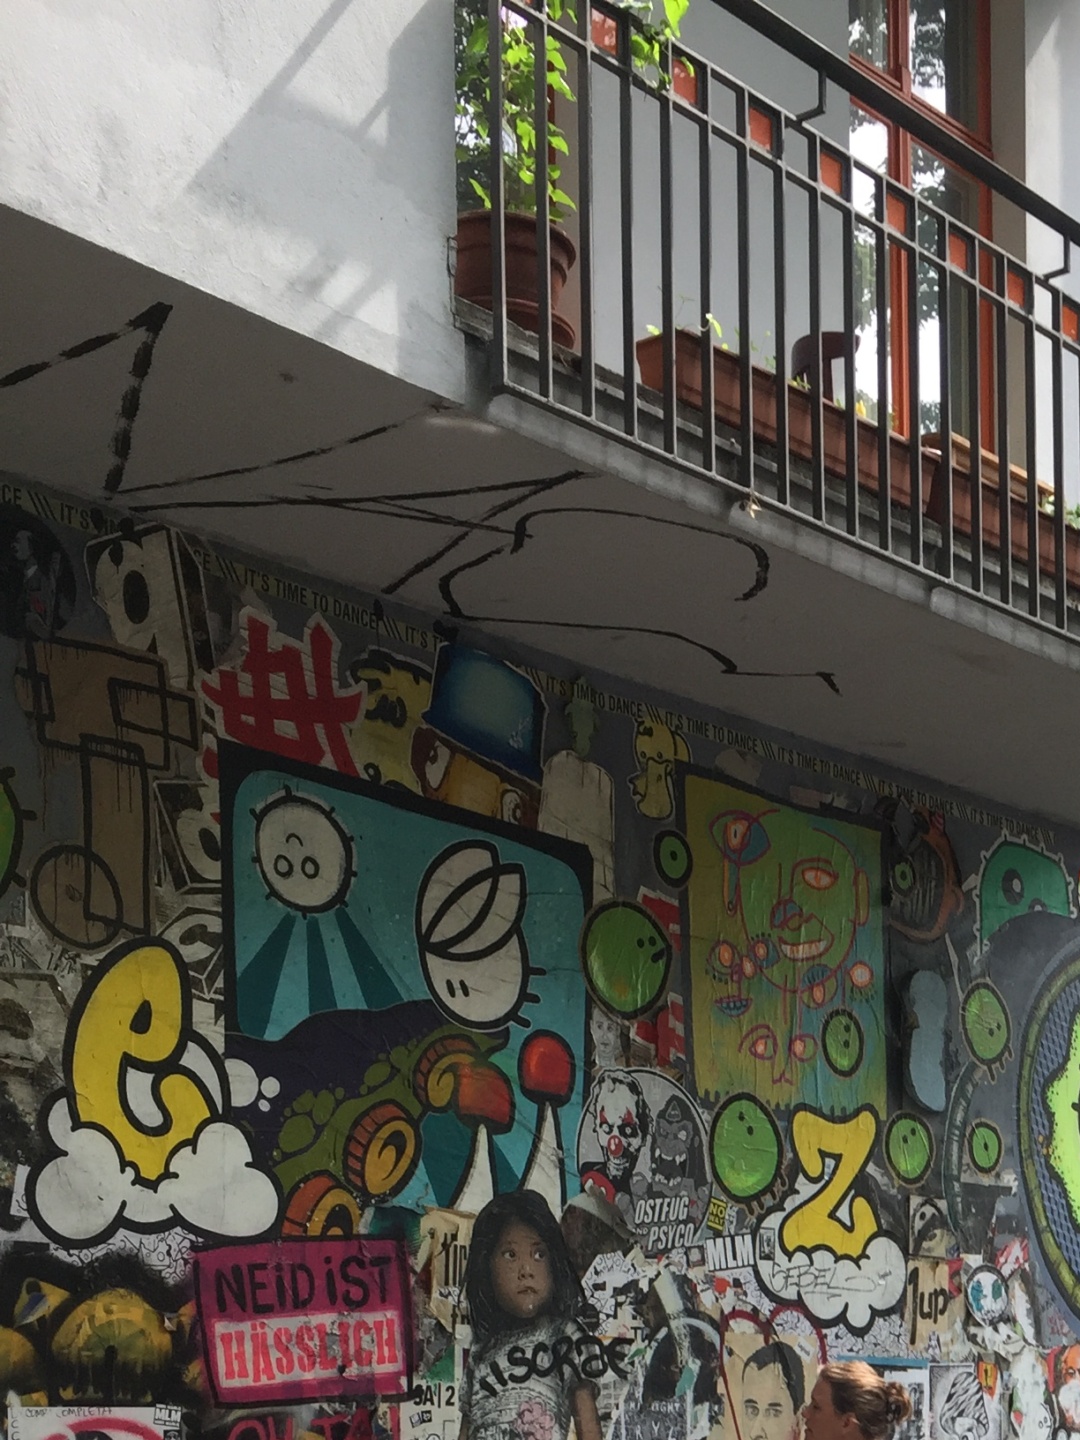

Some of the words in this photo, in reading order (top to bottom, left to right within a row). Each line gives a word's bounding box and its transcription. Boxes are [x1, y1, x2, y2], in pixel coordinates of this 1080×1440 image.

[243, 568, 271, 593] IT'S
[274, 578, 308, 606] TIME
[312, 591, 329, 613] TO
[334, 600, 379, 630] DANCE
[405, 622, 429, 649] IT'S
[545, 674, 567, 697] IT'S
[607, 693, 645, 720] DANCE
[663, 710, 684, 732] IT'S
[684, 715, 710, 738] TIME
[712, 724, 726, 744] TO
[726, 728, 759, 754] DANCE
[796, 750, 818, 773] TIME
[819, 758, 831, 774] TO
[832, 763, 861, 786] DANCE
[916, 791, 927, 806] TO
[928, 795, 954, 817] DANCE
[1004, 817, 1015, 833] TO
[1016, 819, 1039, 840] DANCE
[710, 1202, 727, 1218] NO
[648, 1223, 695, 1252] PSYCO
[707, 1233, 755, 1271] MLM
[220, 1319, 399, 1383] HÄSSLICH
